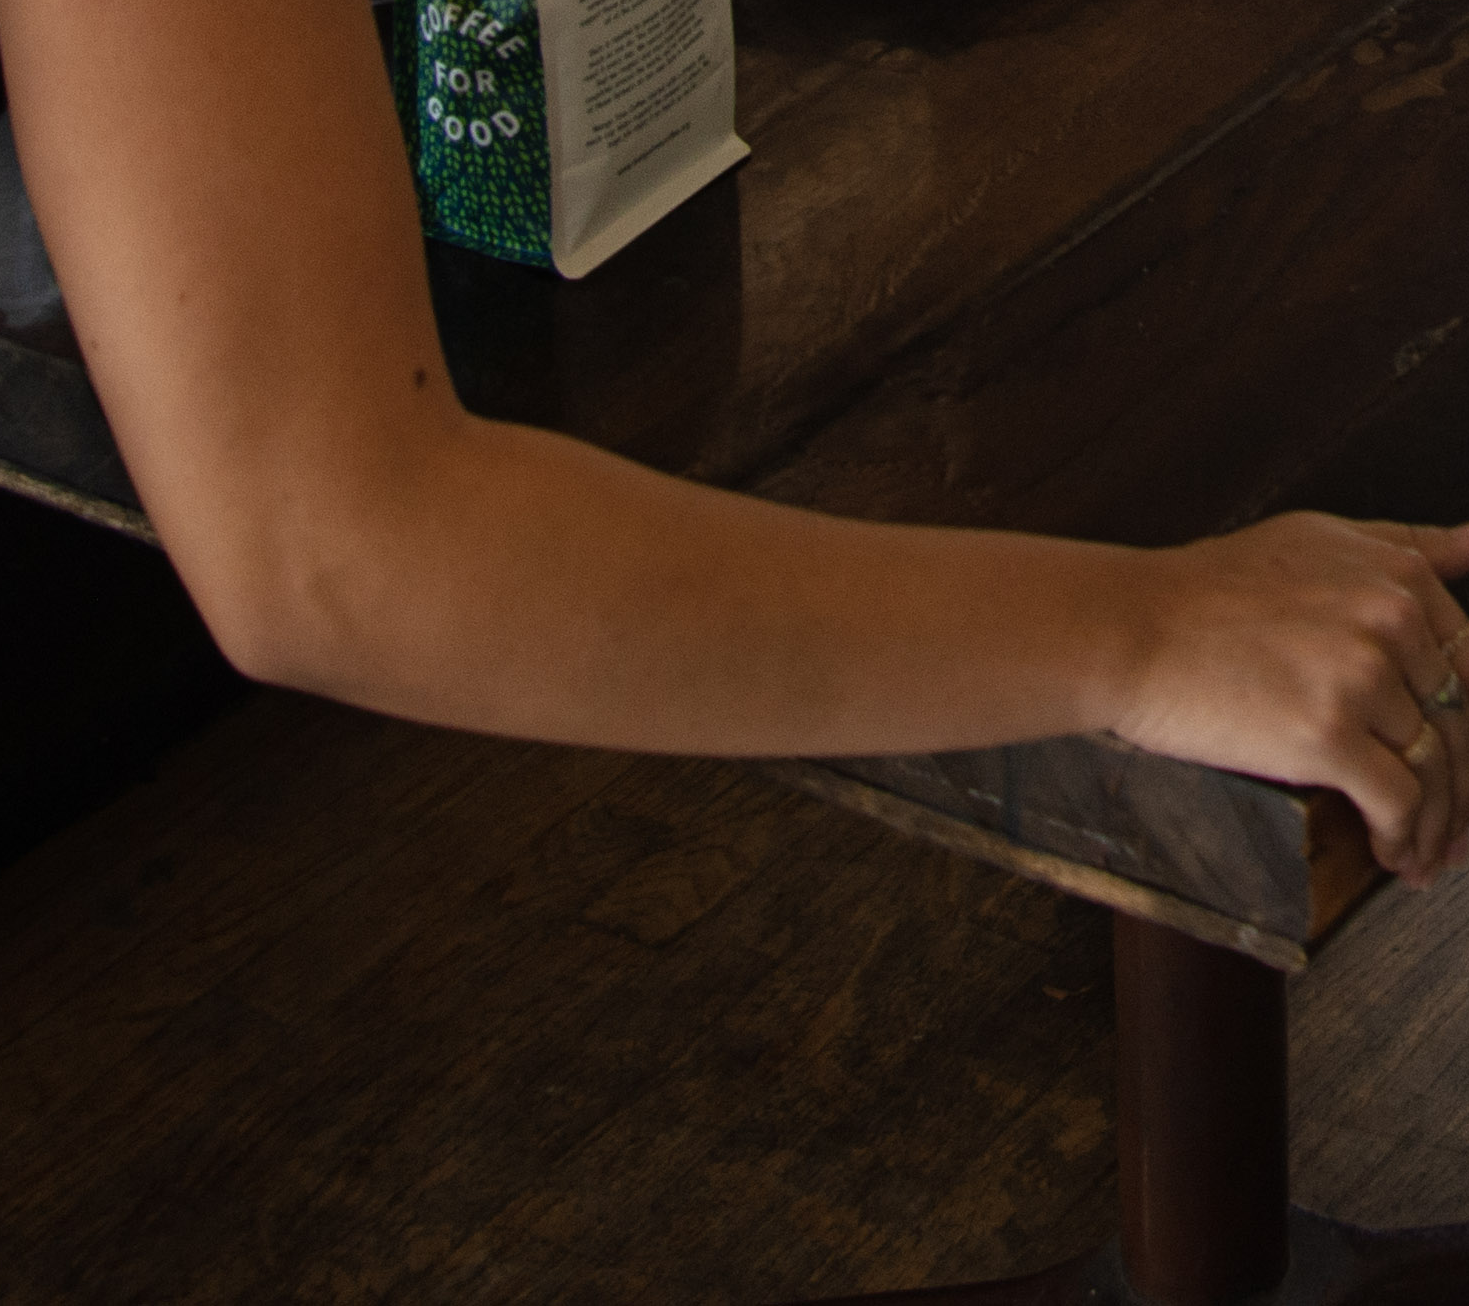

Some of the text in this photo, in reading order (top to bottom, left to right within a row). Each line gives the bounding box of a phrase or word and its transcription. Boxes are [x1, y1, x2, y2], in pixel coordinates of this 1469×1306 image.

[420, 3, 525, 59] COFFEE
[434, 60, 496, 94] FOR
[427, 97, 520, 146] GOOD
